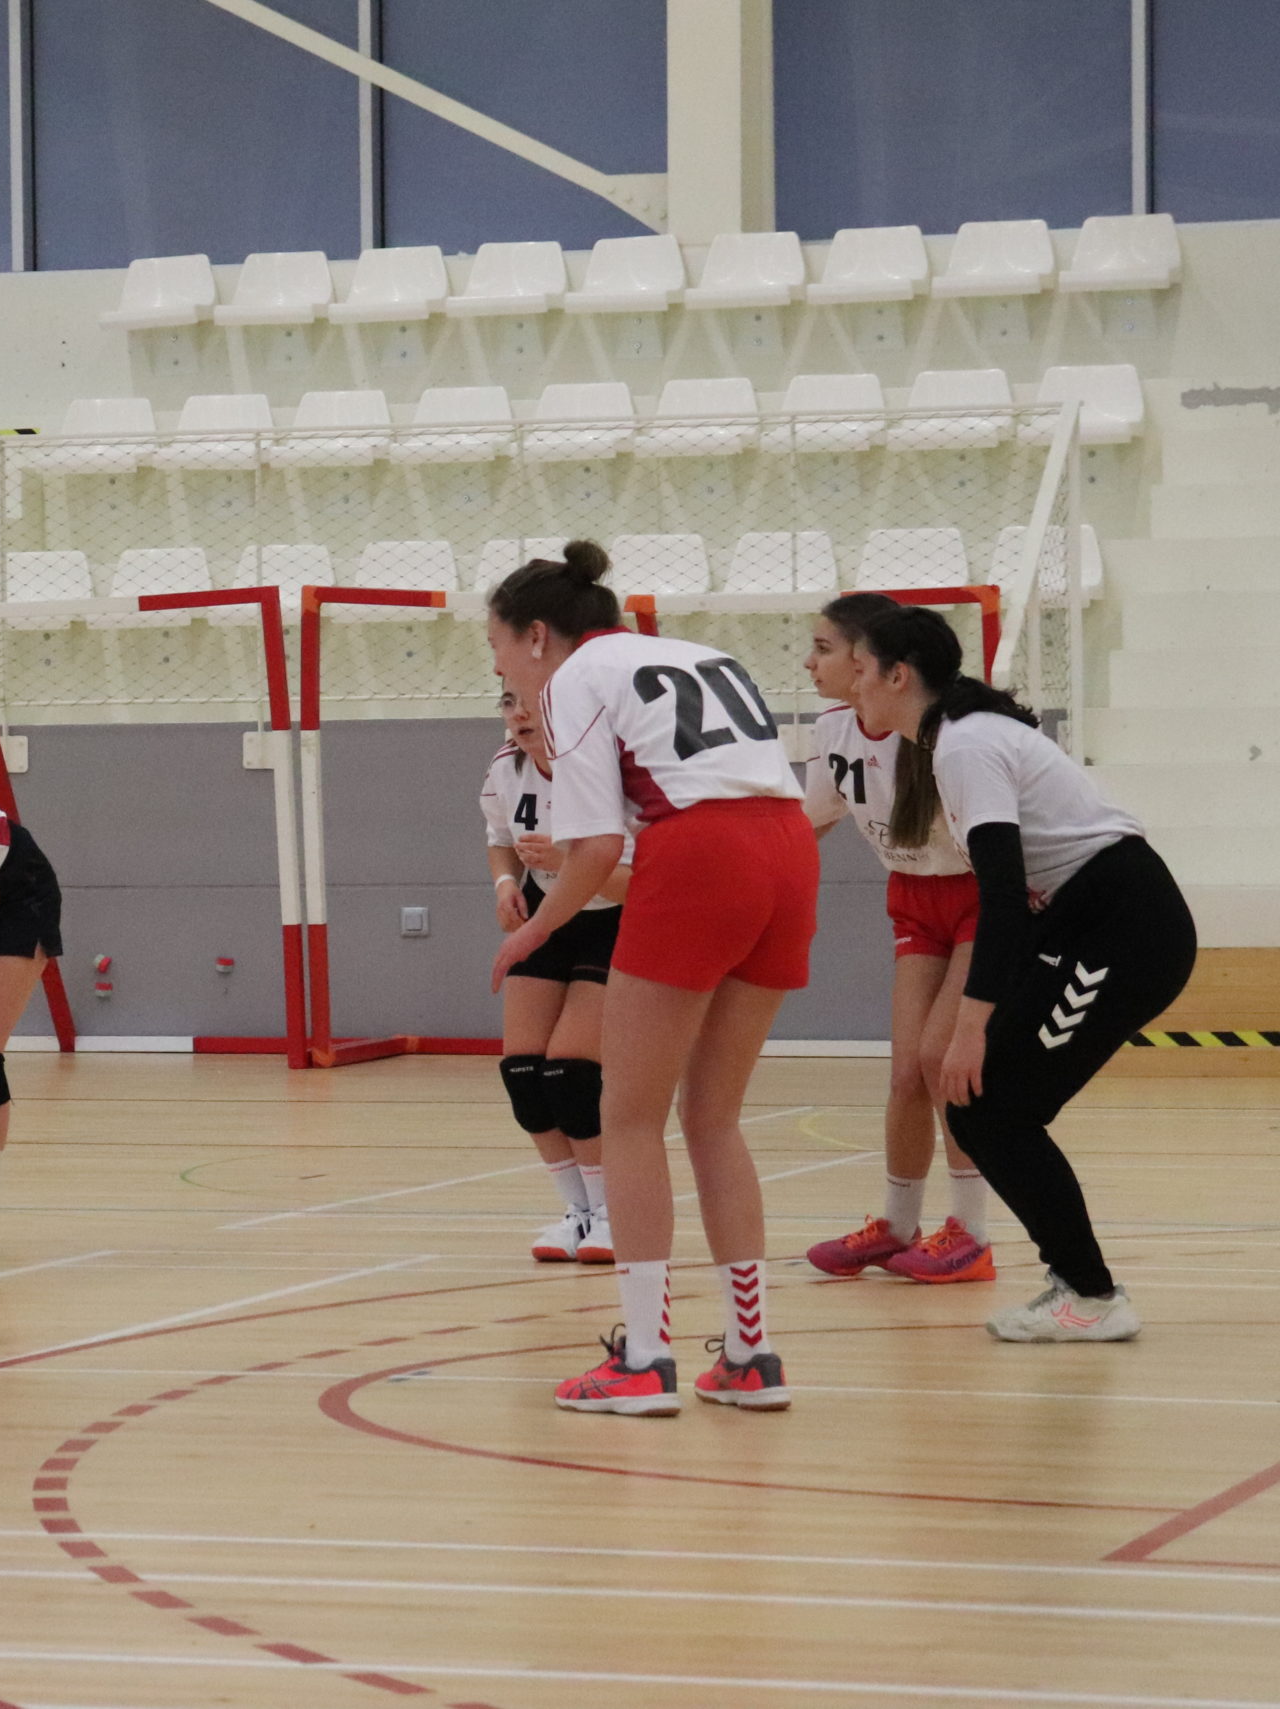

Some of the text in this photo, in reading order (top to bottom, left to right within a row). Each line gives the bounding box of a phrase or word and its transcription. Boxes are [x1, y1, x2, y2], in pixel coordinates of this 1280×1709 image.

[632, 656, 779, 762] 20
[828, 752, 867, 804] 21
[513, 792, 539, 831] 4
